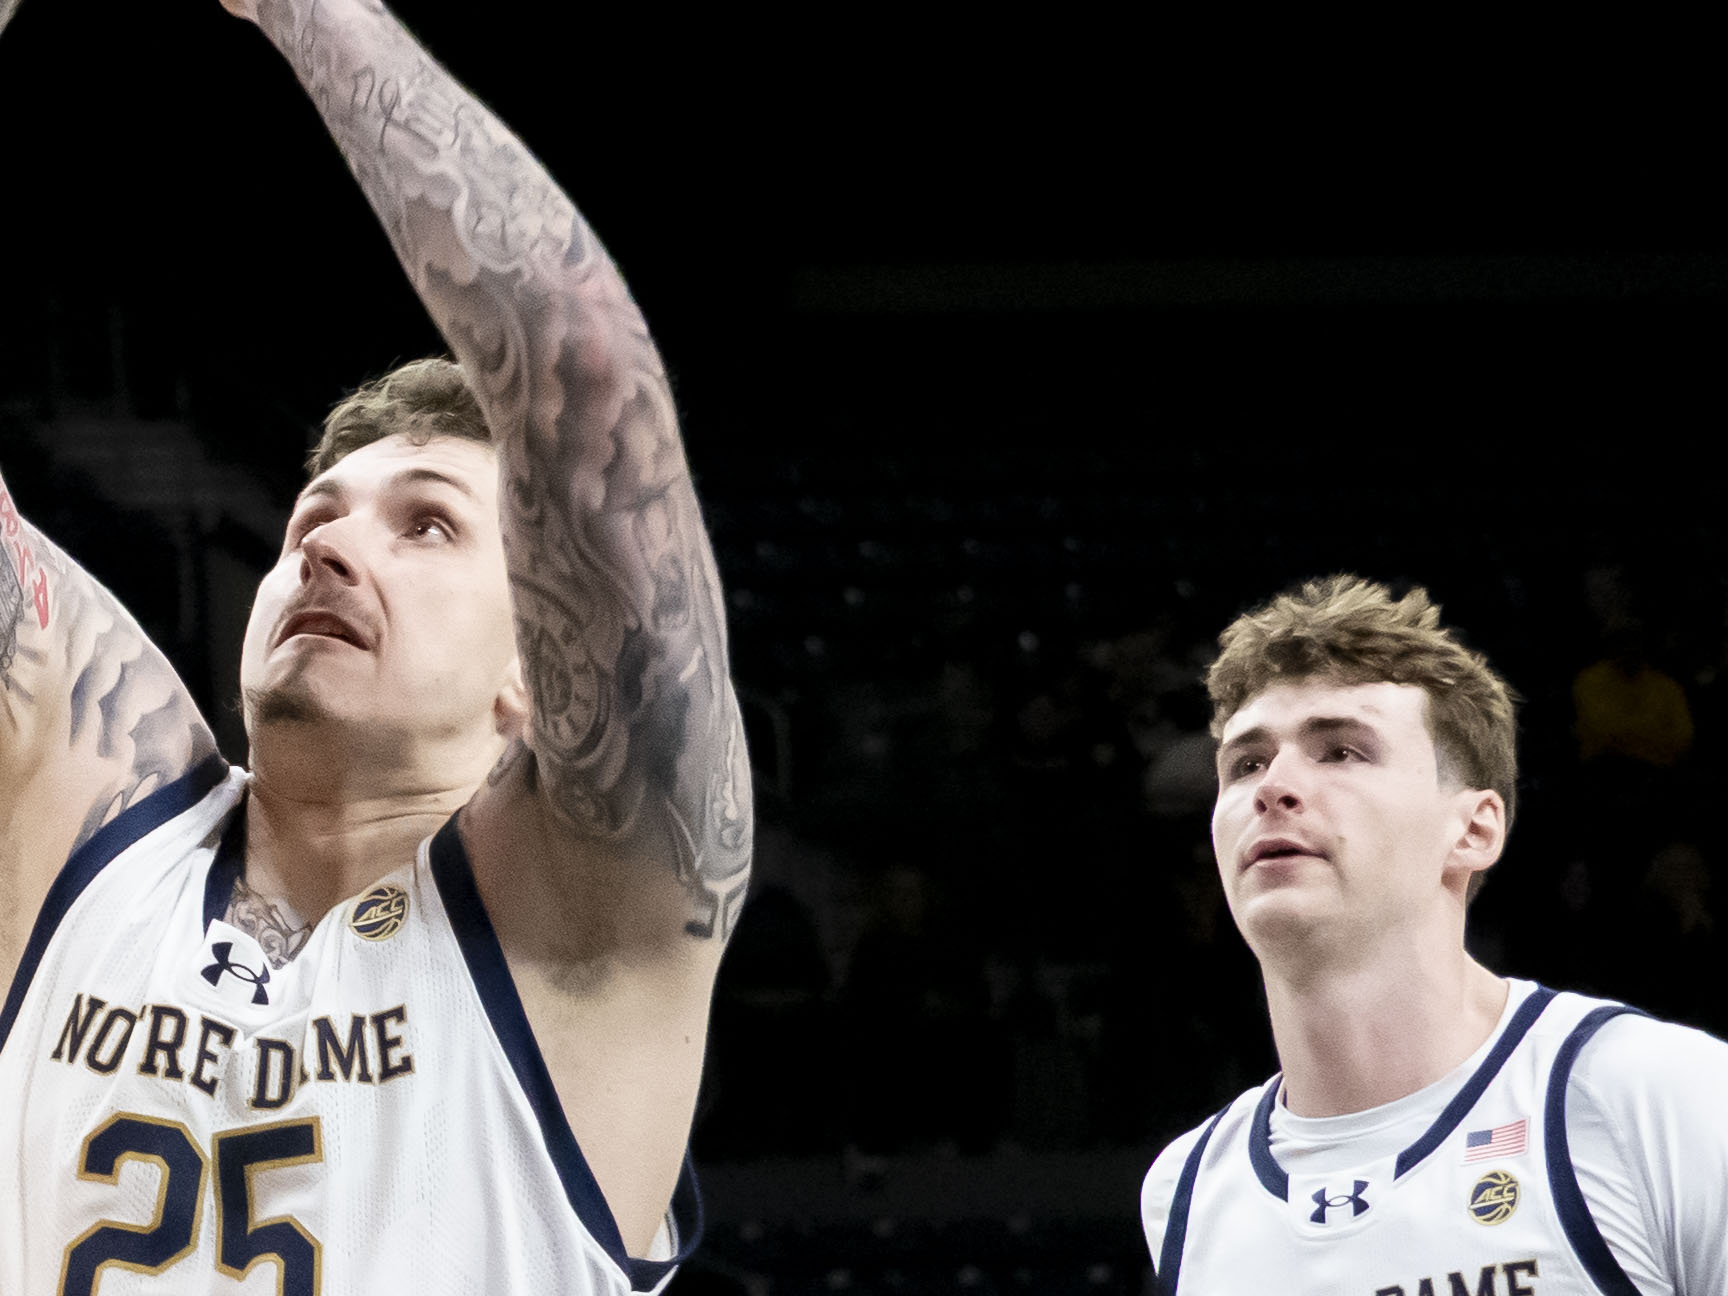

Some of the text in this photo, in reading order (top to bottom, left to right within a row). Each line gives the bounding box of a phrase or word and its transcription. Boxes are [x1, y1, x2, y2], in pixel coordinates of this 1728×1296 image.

[360, 896, 406, 925] ACC
[51, 993, 416, 1111] NORE DME
[1474, 1181, 1518, 1206] ACC
